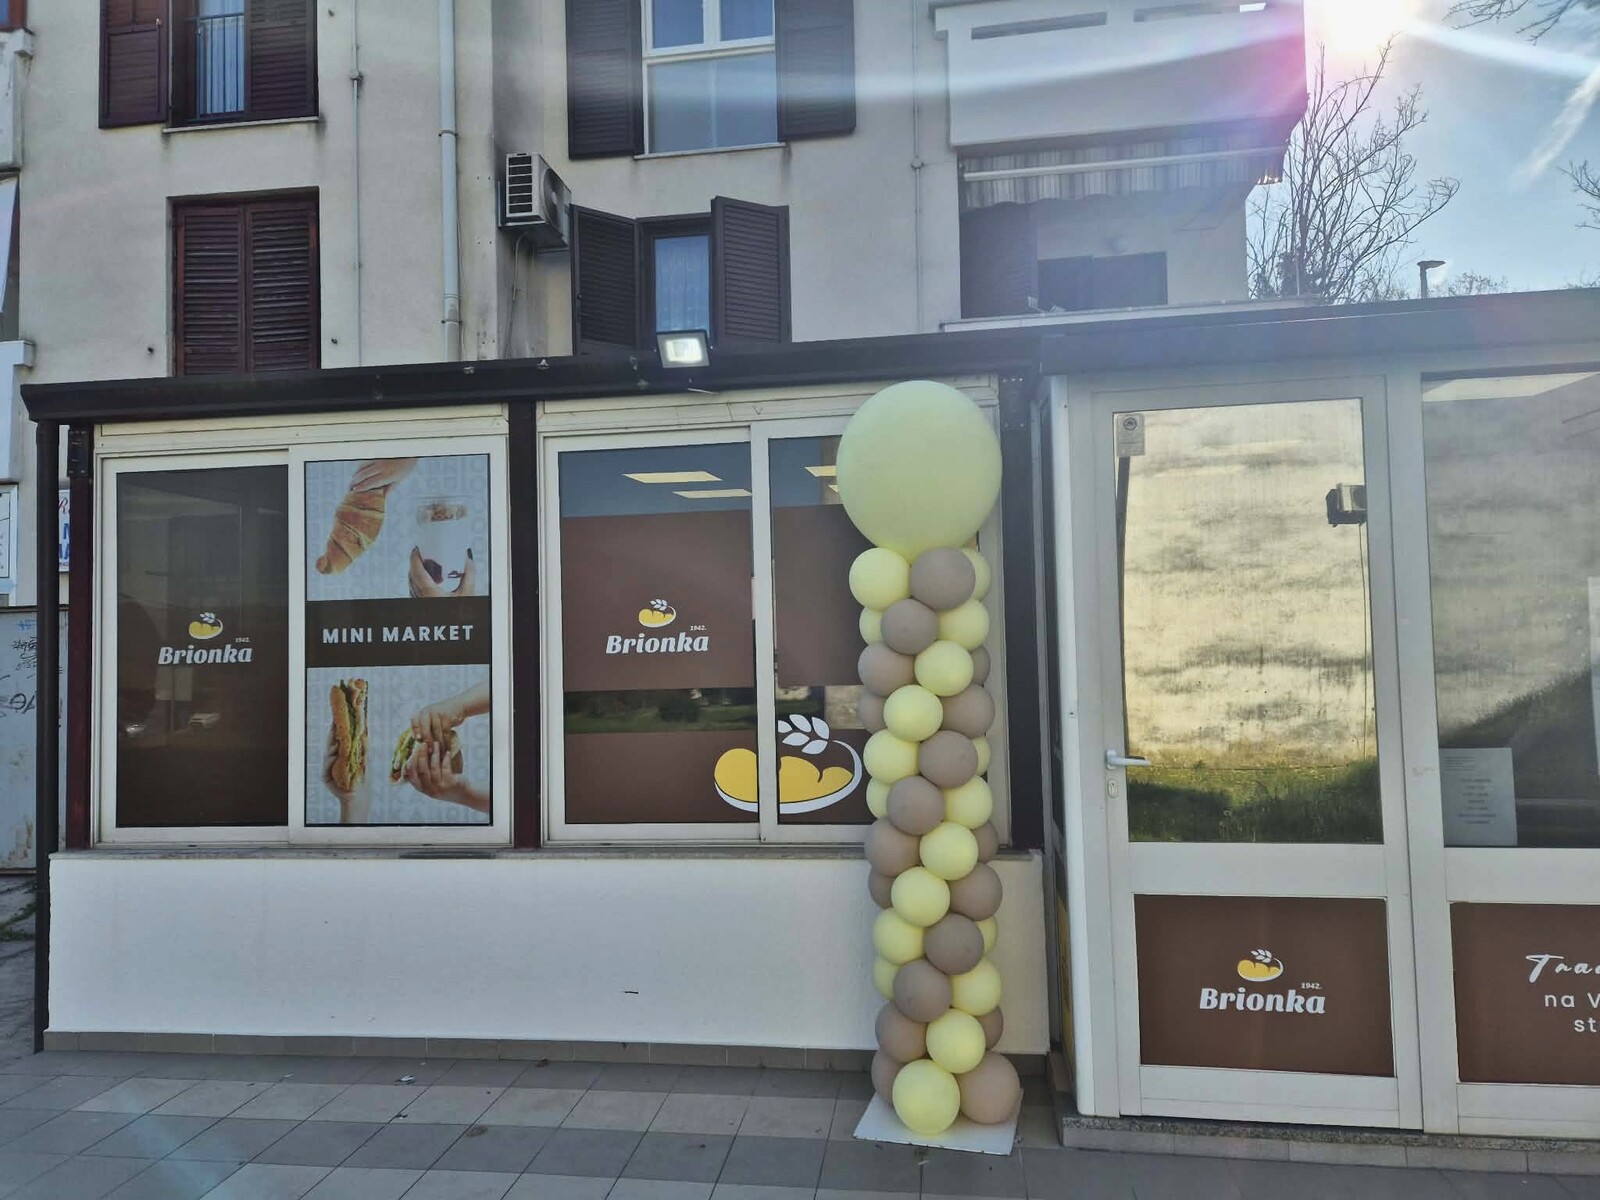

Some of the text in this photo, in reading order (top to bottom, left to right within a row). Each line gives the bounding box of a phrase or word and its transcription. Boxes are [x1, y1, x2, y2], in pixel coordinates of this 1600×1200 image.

[322, 624, 474, 644] MINI MARKET
[605, 631, 709, 654] Brionka
[158, 643, 253, 665] Brionka
[1199, 986, 1326, 1014] Brionka
[1544, 994, 1576, 1008] na
